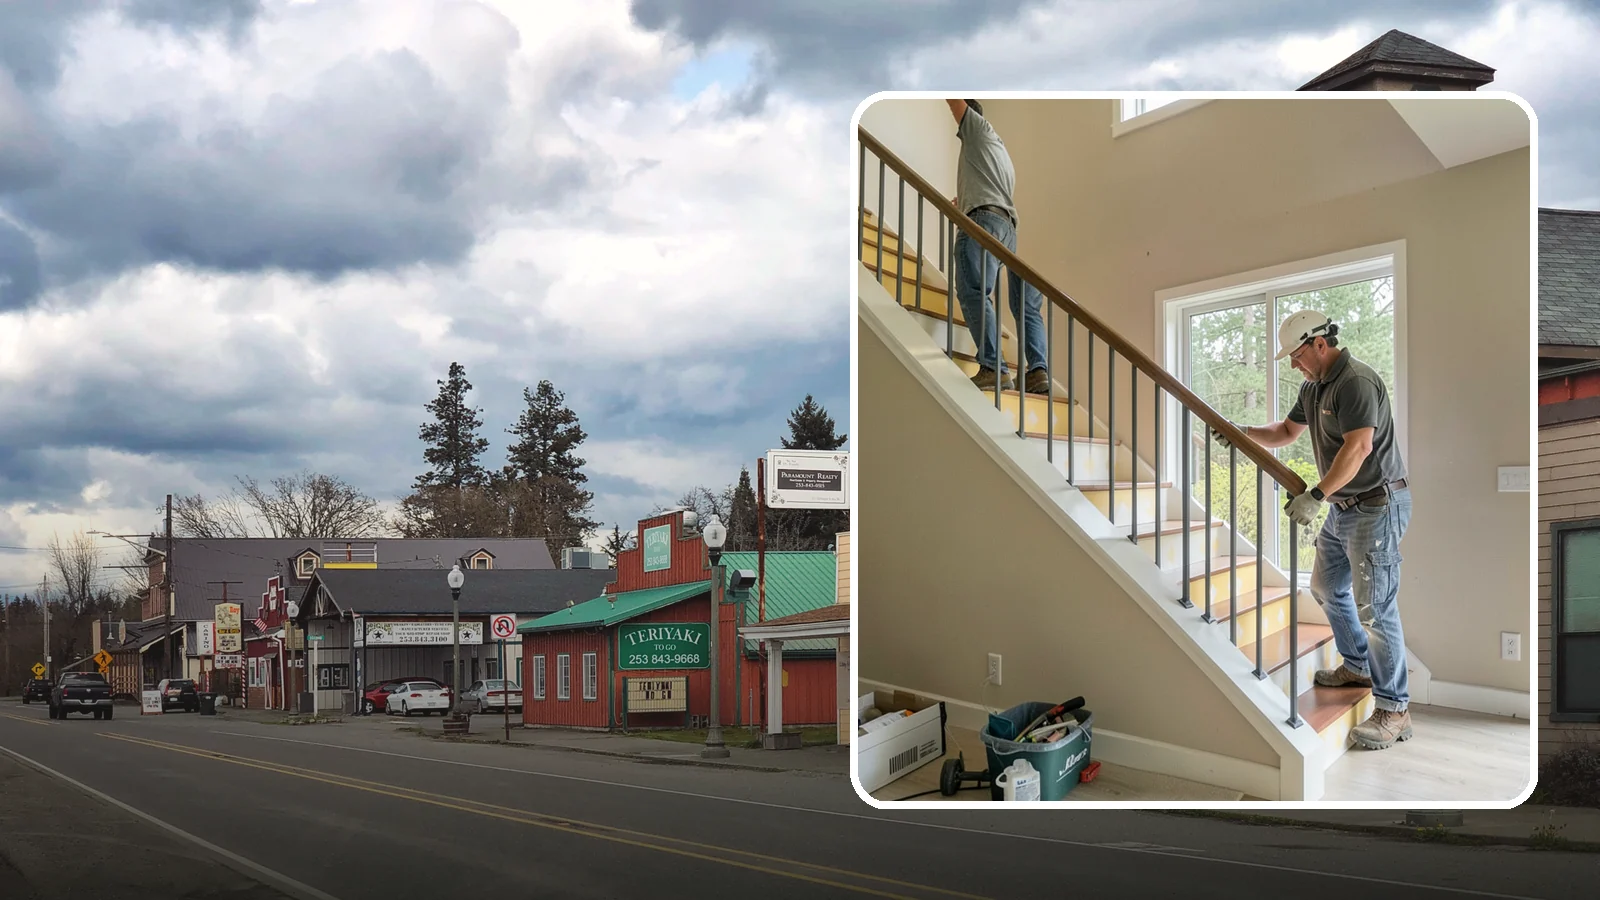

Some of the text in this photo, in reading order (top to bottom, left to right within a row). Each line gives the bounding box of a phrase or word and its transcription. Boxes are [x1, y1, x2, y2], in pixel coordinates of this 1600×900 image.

[625, 627, 702, 646] TERIYAKI
[629, 654, 700, 664] 253 843-9668
